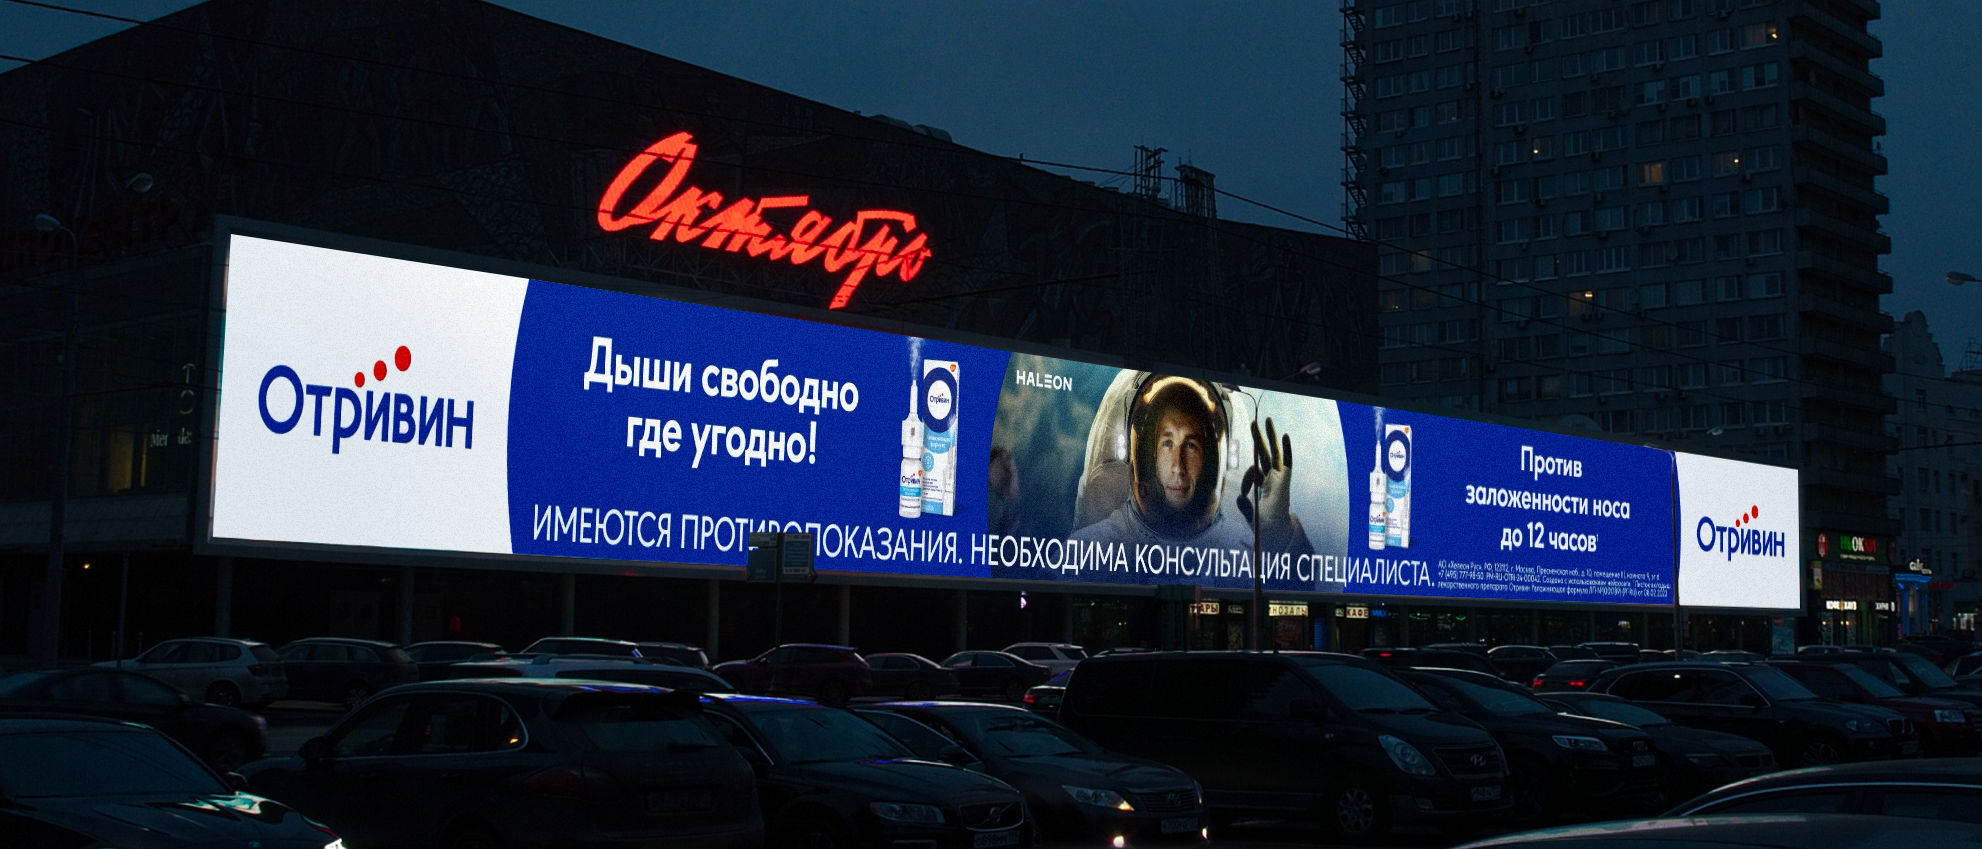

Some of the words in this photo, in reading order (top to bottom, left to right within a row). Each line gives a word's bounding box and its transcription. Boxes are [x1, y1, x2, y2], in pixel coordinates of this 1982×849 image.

[583, 336, 692, 393] Дыши
[701, 358, 859, 415] свободно
[1016, 370, 1073, 392] HALEON
[258, 364, 475, 455] Отривин
[626, 416, 683, 459] где
[690, 420, 817, 469] угодно!
[1520, 445, 1583, 481] Против
[1465, 484, 1589, 515] заложенности
[1592, 499, 1631, 519] носа
[533, 503, 672, 548] ИМЕЮТСЯ
[970, 533, 1129, 576] НЕОБХОДИМА
[1135, 544, 1291, 584] КОНСУЛЬТАЦИЯ
[1296, 553, 1435, 588] СПЕЦИАЛИСТА.
[1500, 527, 1523, 551] до
[1526, 521, 1545, 549] 12
[1696, 515, 1785, 562] Отривин
[1346, 607, 1369, 618] КАФЕ
